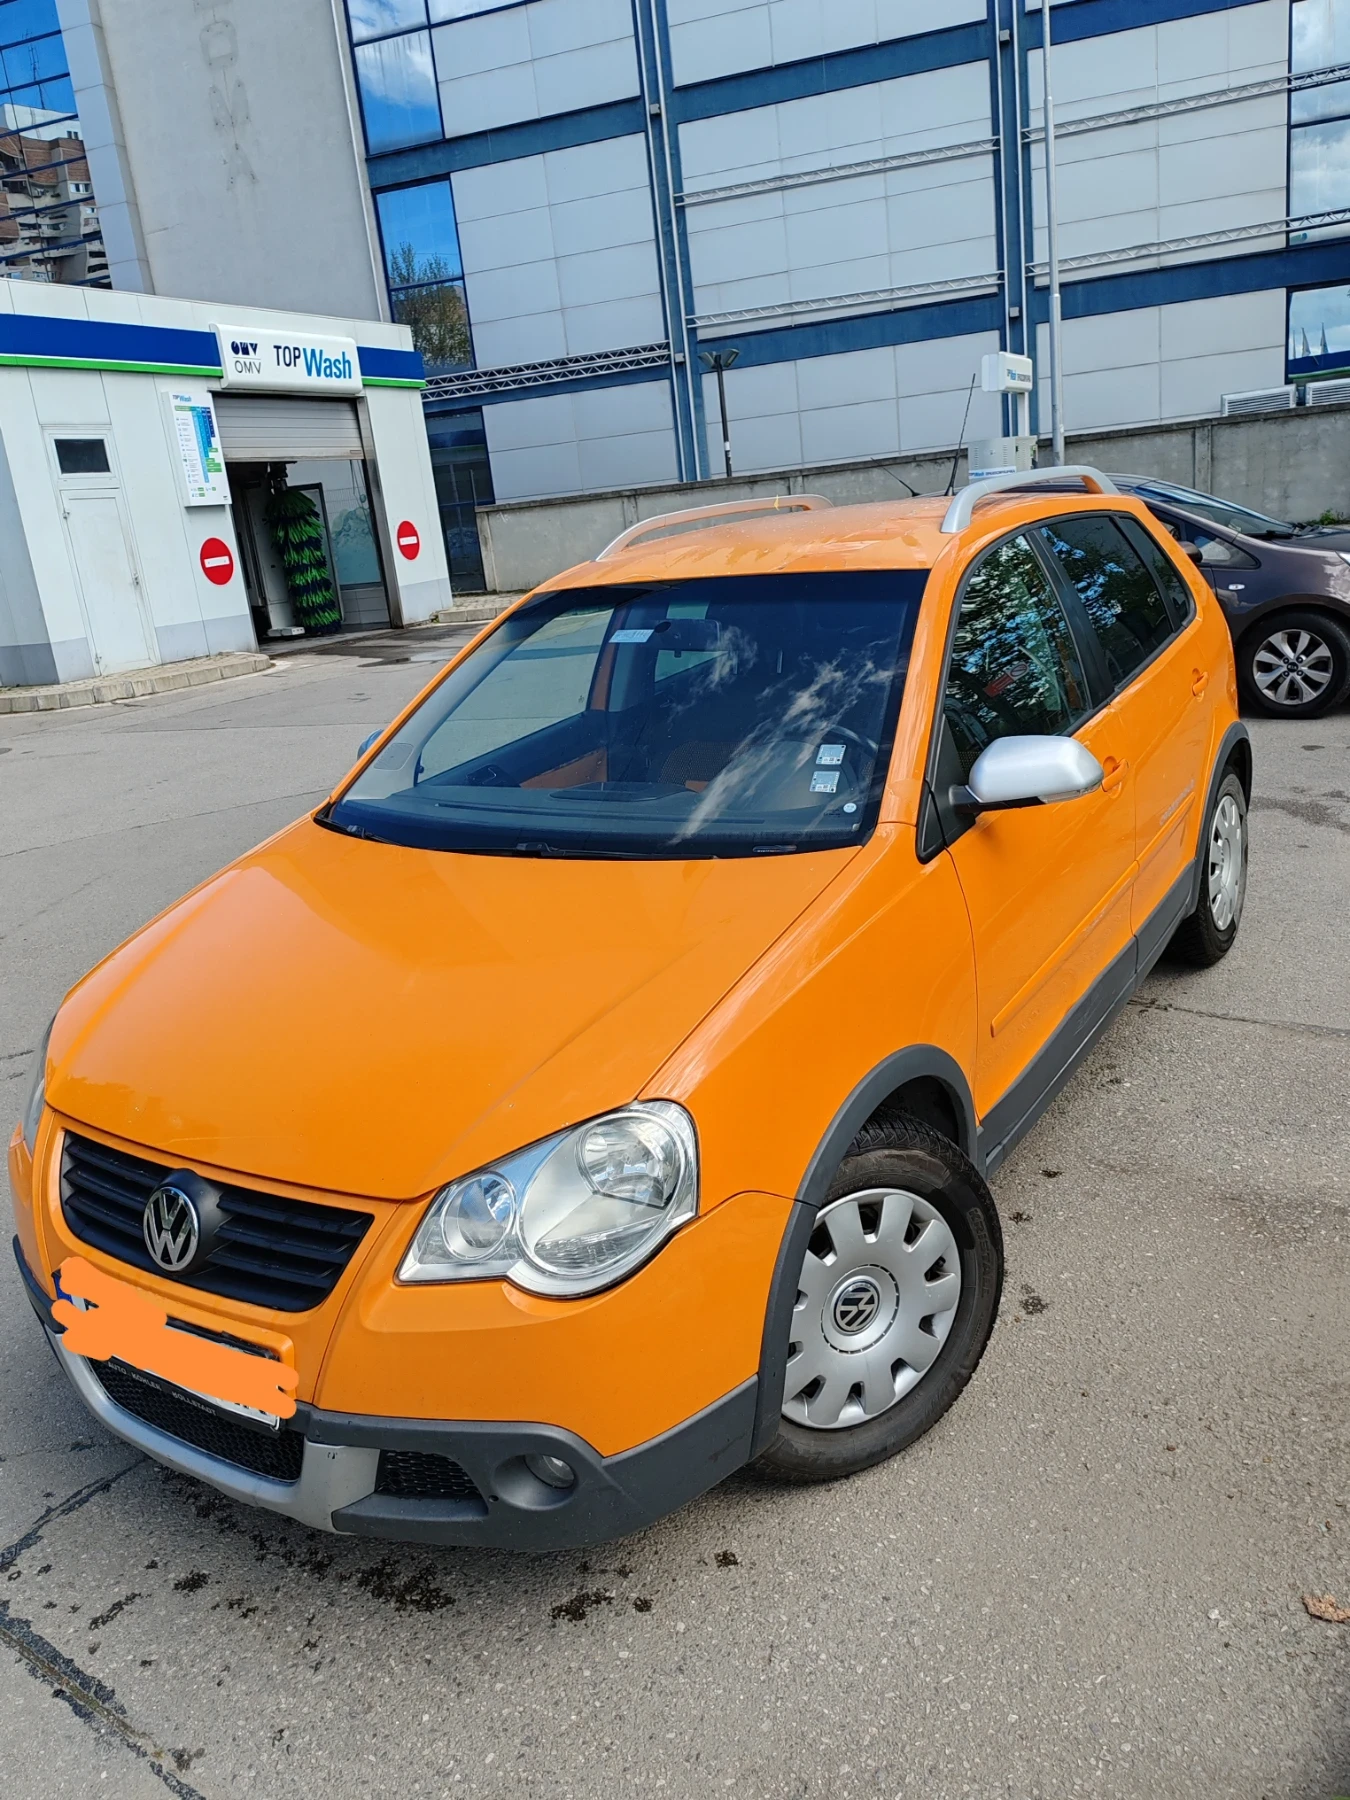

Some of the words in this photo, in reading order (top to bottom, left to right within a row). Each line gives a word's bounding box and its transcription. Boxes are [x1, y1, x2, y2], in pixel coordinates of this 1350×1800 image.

[234, 360, 262, 375] OMV
[273, 345, 302, 368] TOP
[302, 347, 353, 379] Wash
